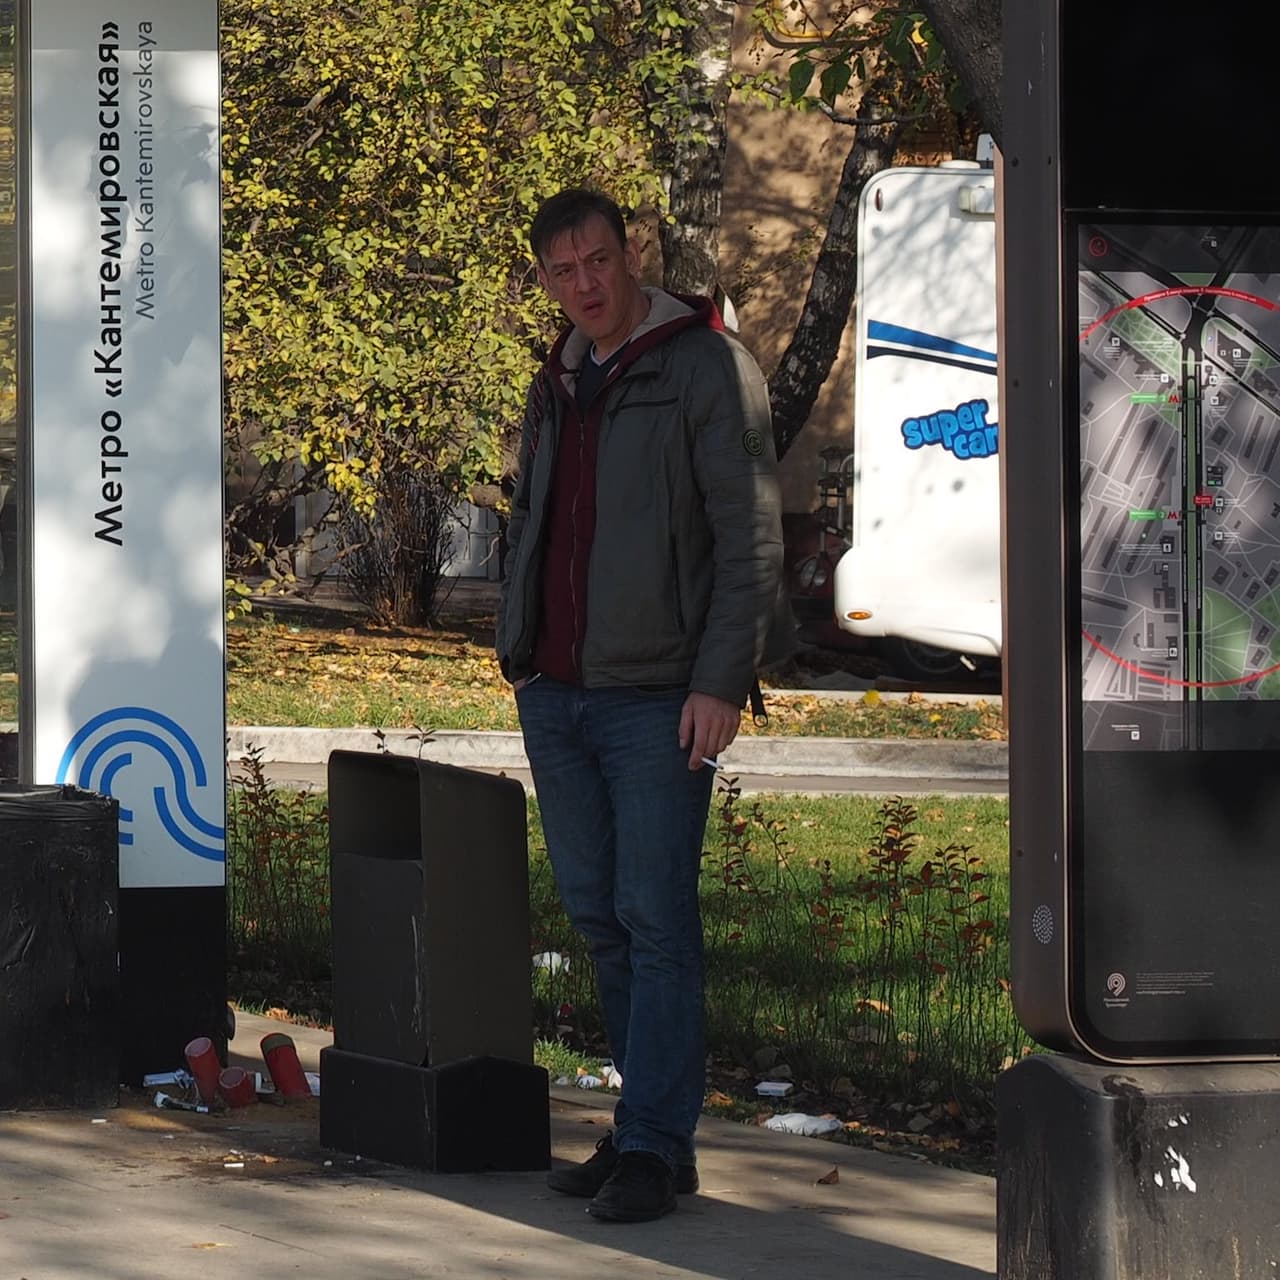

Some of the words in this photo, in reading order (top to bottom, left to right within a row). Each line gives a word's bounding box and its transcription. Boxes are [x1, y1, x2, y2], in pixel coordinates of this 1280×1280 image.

[134, 20, 158, 233] Kantemirovskaya
[93, 20, 128, 398] «Кантемировская»
[135, 239, 156, 320] Metro
[94, 410, 129, 547] Метро
[902, 400, 987, 448] super
